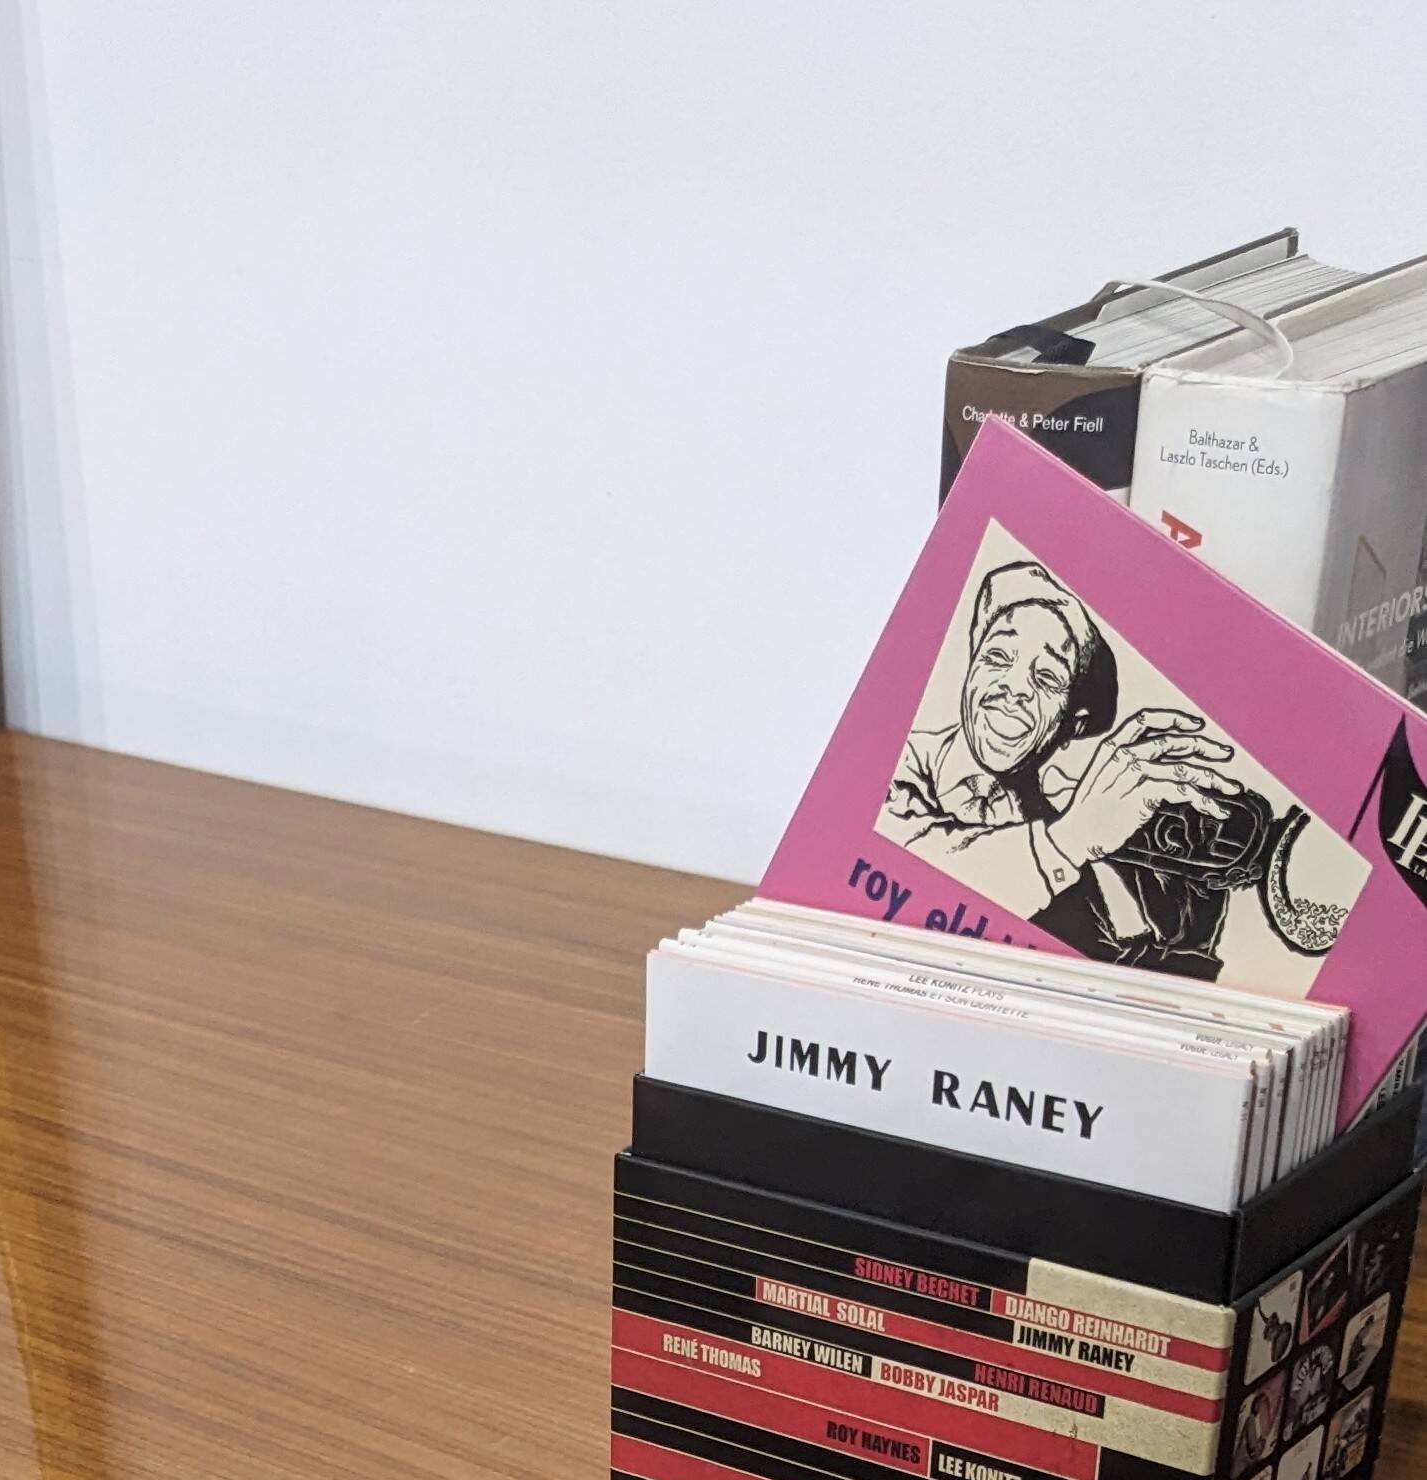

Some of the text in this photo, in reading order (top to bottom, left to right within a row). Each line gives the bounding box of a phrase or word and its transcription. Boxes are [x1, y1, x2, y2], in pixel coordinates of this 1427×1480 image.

[1020, 412, 1030, 428] &
[1032, 413, 1070, 431] Peter
[1073, 416, 1104, 433] Fiell
[1189, 429, 1259, 452] Balthazar &
[1159, 446, 1289, 478] Laszlo Taschen (Eds.)
[848, 857, 913, 922] roy
[747, 1030, 1104, 1140] JIMMY RANEY
[853, 1256, 980, 1307] SIDNEY BECHET
[762, 1281, 886, 1333] MARTIAL SOLAL
[1005, 1295, 1172, 1357] DJANGO REINHARDT
[662, 1332, 762, 1378] RENÉ THOMAS
[751, 1325, 864, 1375] BARNEY WILEN
[1017, 1325, 1136, 1373] JIMMY RANEY
[879, 1362, 1000, 1412] BOBBY JASPAR
[973, 1363, 1099, 1415] HENRI RENAUD
[826, 1420, 922, 1465] ROY HAYNES
[937, 1452, 964, 1478] LEE
